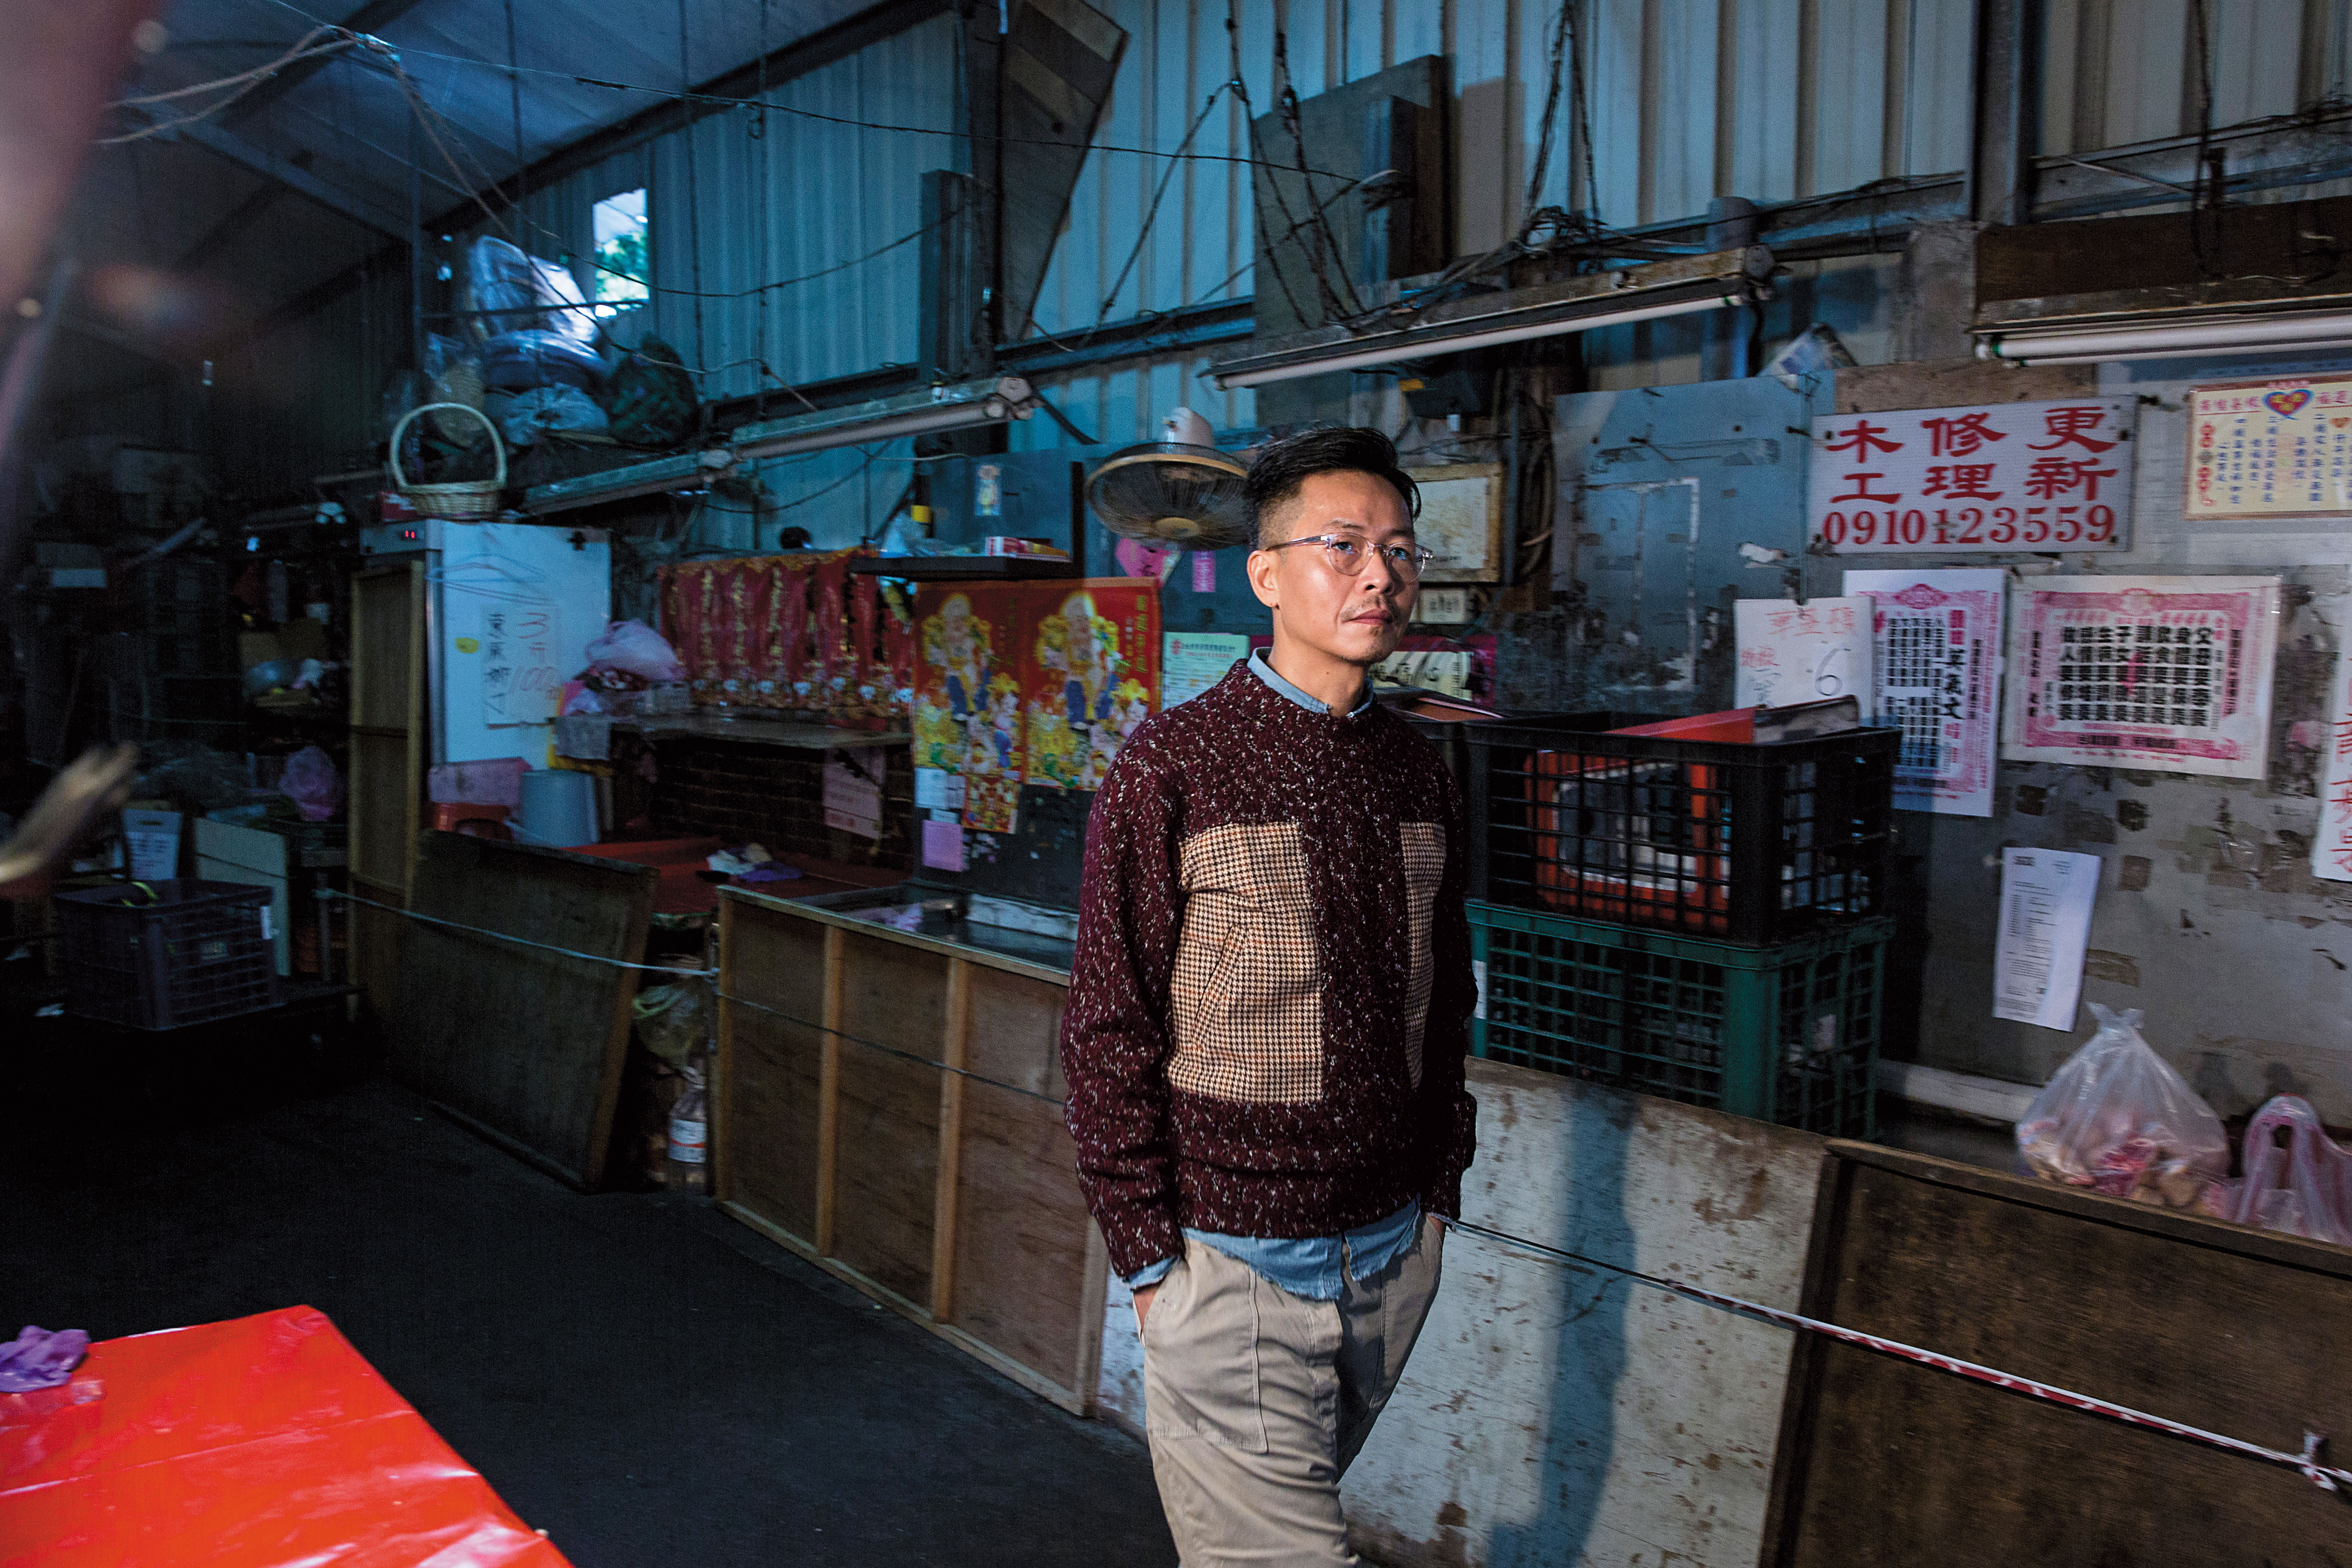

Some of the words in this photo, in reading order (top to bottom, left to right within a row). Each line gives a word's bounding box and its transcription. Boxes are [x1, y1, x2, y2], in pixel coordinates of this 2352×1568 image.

[1826, 420, 1904, 504] 木工
[1921, 412, 2007, 501] 修理
[2027, 406, 2117, 501] 更新
[1822, 505, 2115, 545] 0910123559
[1815, 647, 1851, 696] 6
